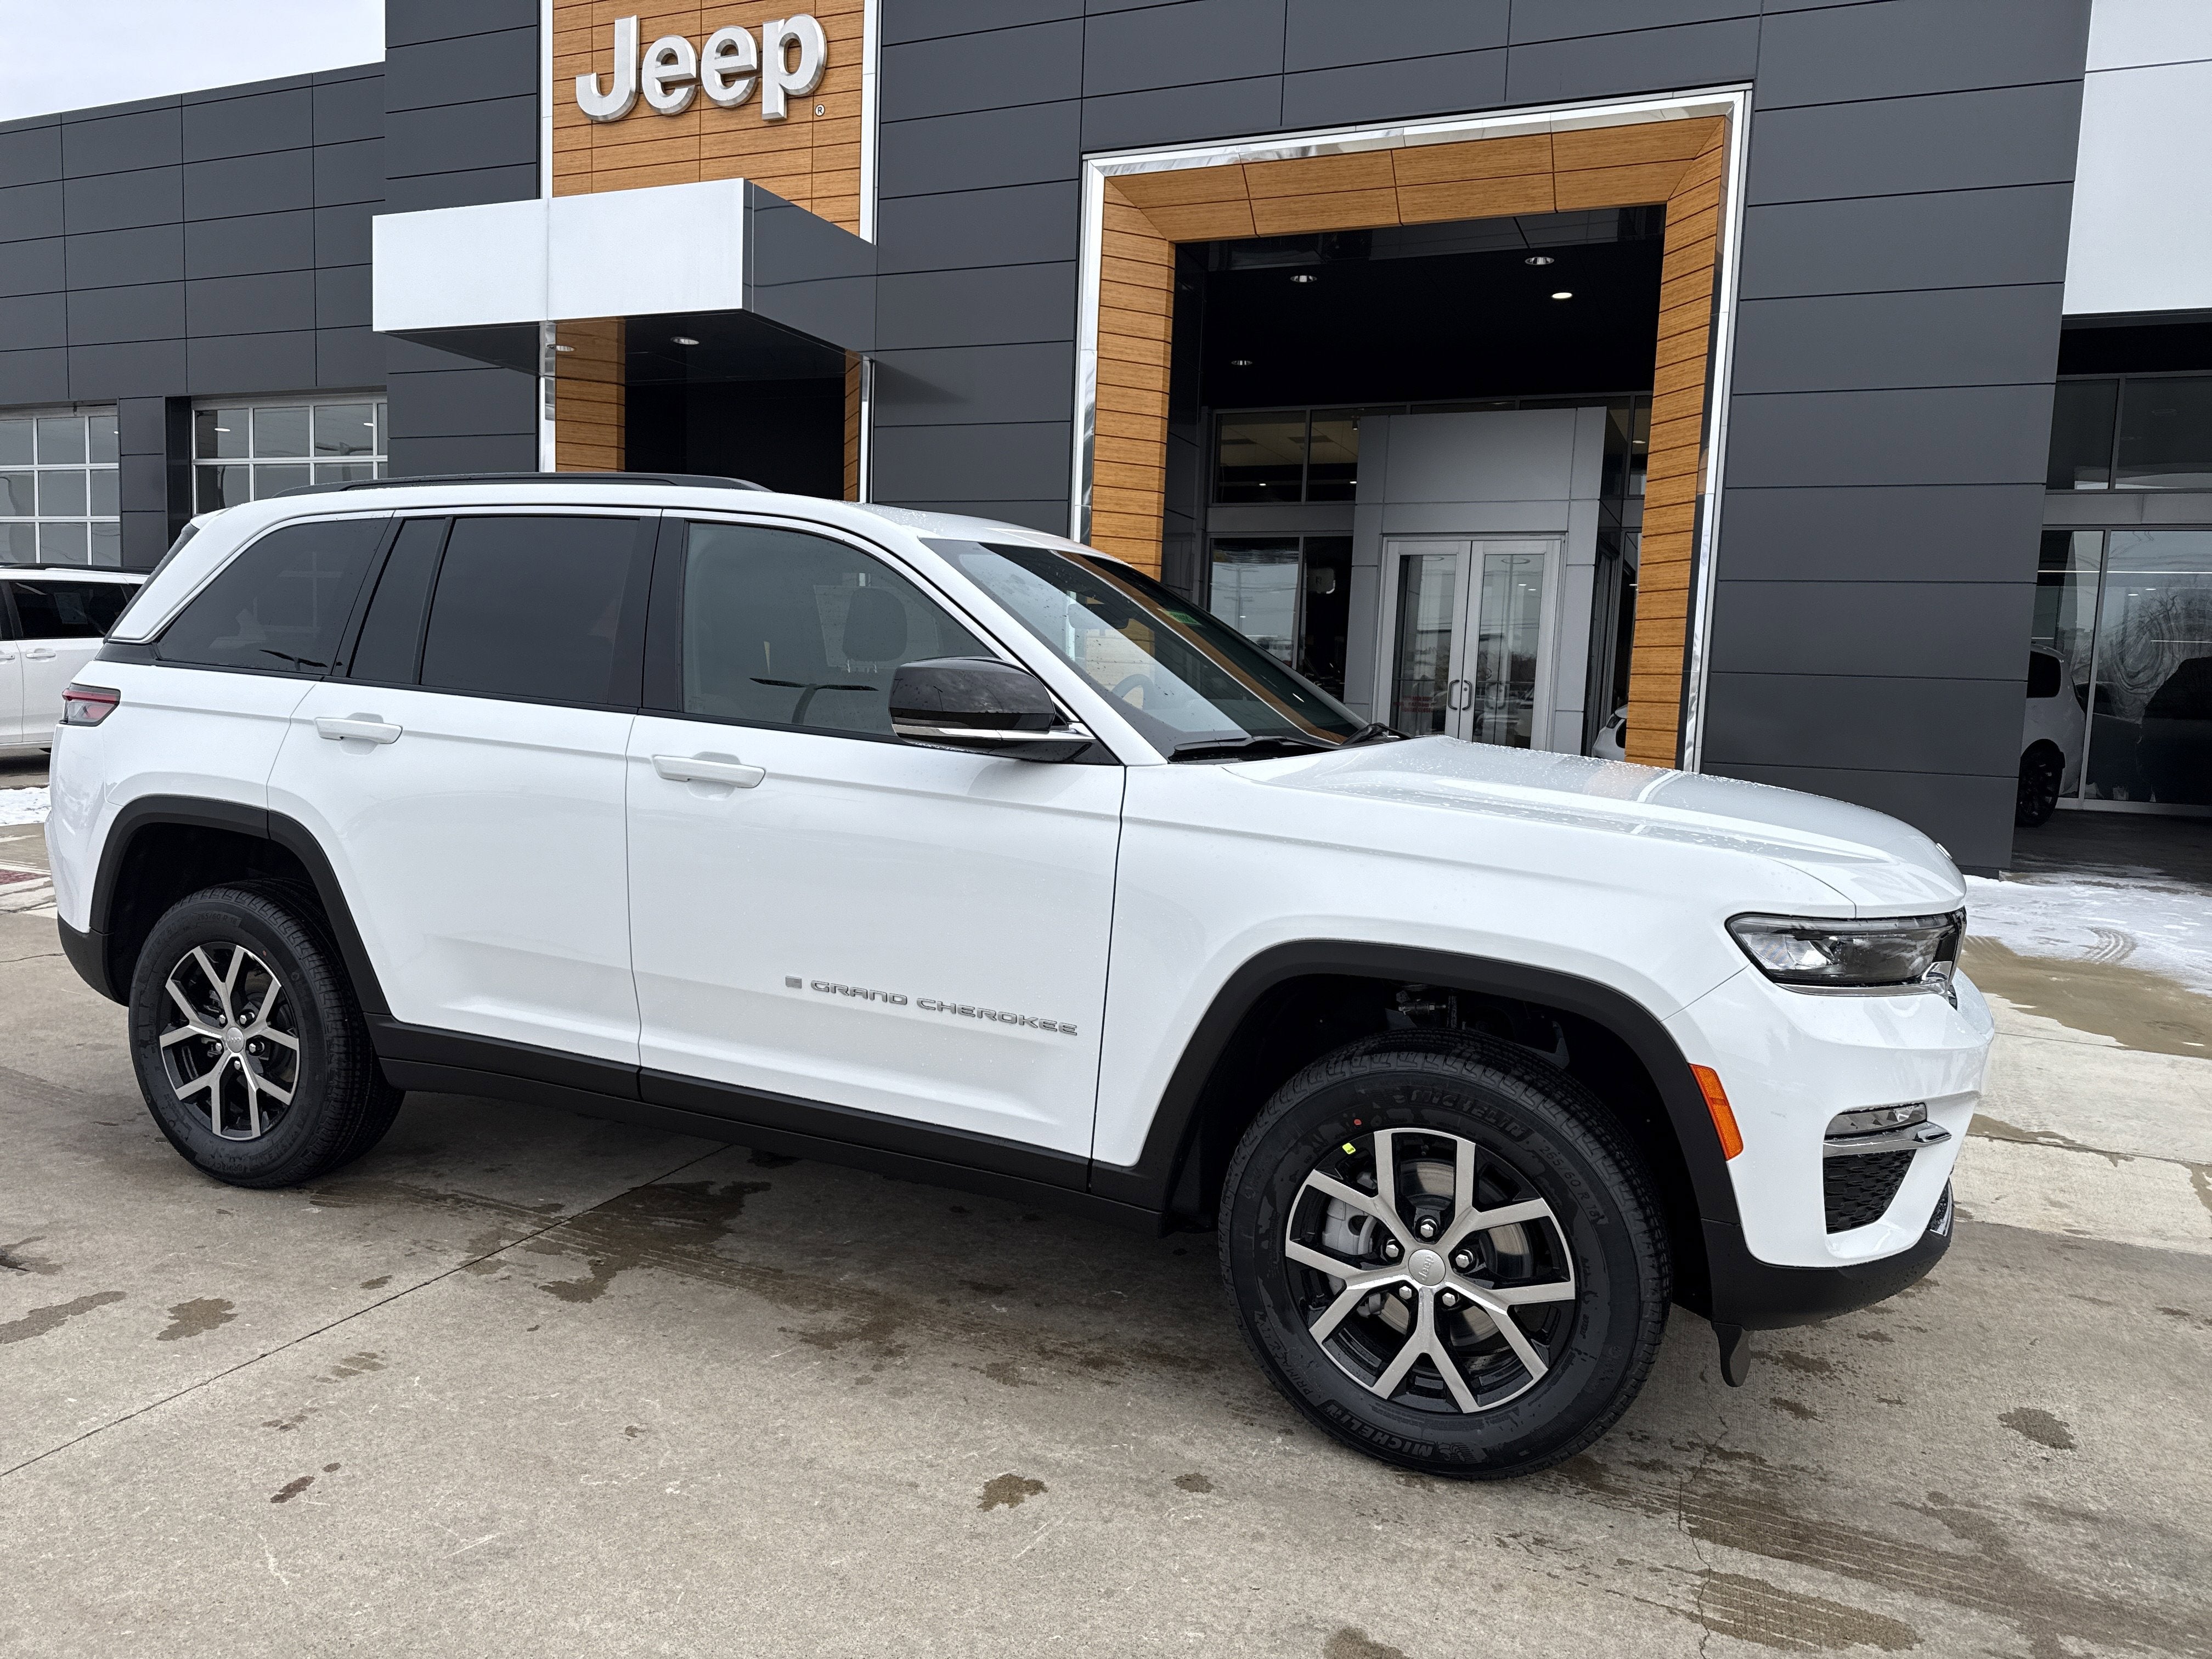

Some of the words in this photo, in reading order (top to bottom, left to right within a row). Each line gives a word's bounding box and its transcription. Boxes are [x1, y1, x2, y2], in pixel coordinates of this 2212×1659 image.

[575, 14, 828, 122] Jeep
[810, 980, 908, 1006] GRAND
[916, 997, 1078, 1036] CHEROKEE
[1539, 1146, 1581, 1188] 265/60
[1577, 1191, 1590, 1200] R
[1418, 1255, 1434, 1281] Jeep
[1268, 1341, 1313, 1396] PRIMACY
[1323, 1403, 1433, 1458] MICHELIN
